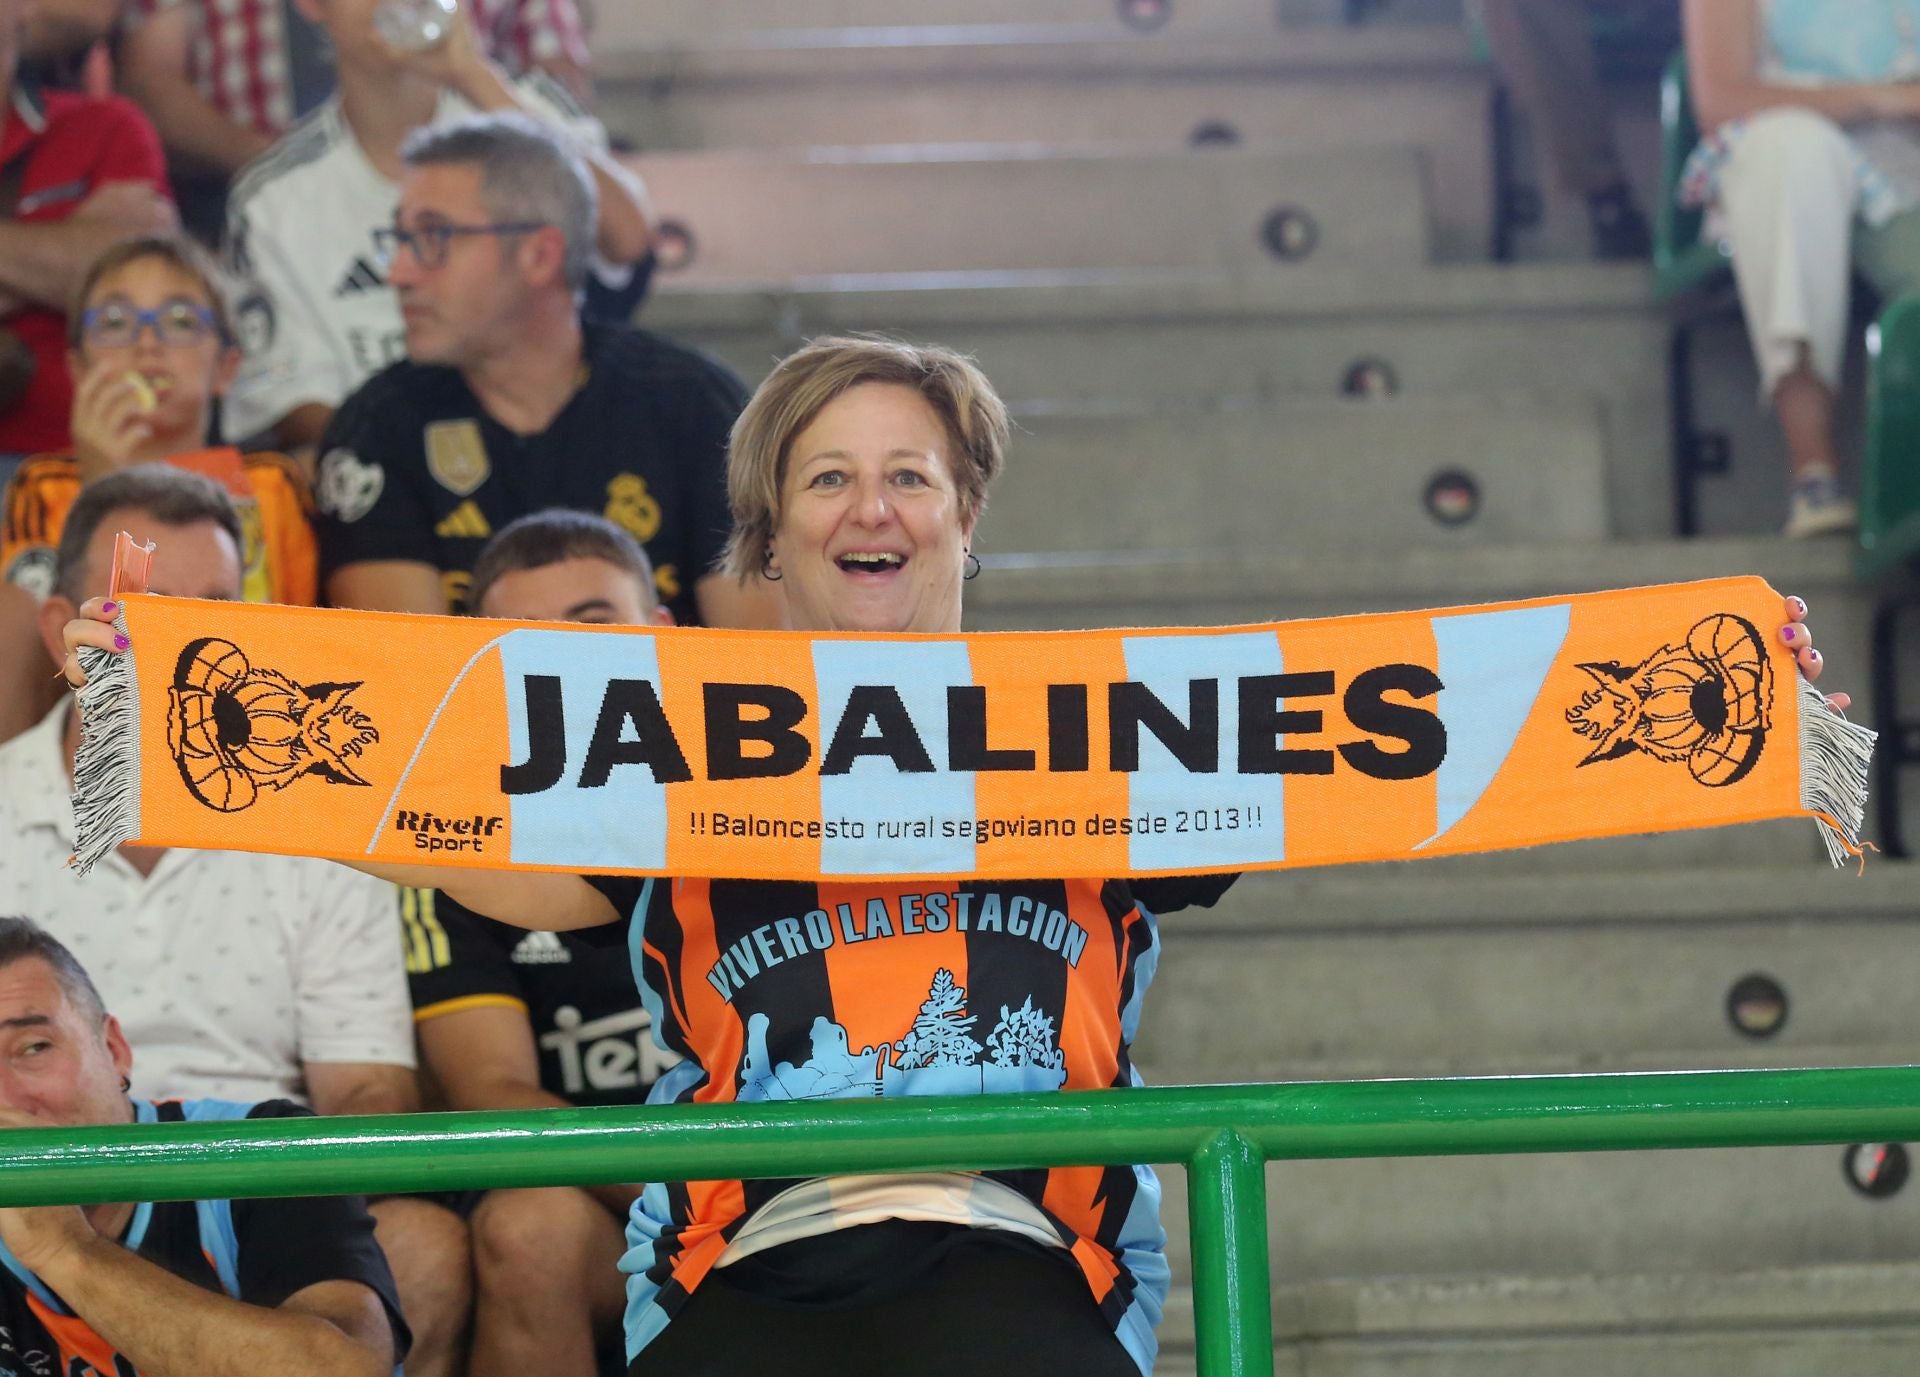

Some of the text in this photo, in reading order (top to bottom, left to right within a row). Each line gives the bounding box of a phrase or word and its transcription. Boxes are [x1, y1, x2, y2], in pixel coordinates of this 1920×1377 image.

[500, 662, 1448, 796] JABALINES
[414, 832, 483, 853] Sport
[877, 815, 934, 838] rural
[941, 814, 1076, 844] segoviano
[1085, 812, 1167, 837] desde
[706, 892, 1089, 1005] VIVERO LA ESTACION
[540, 1005, 685, 1093] Tek
